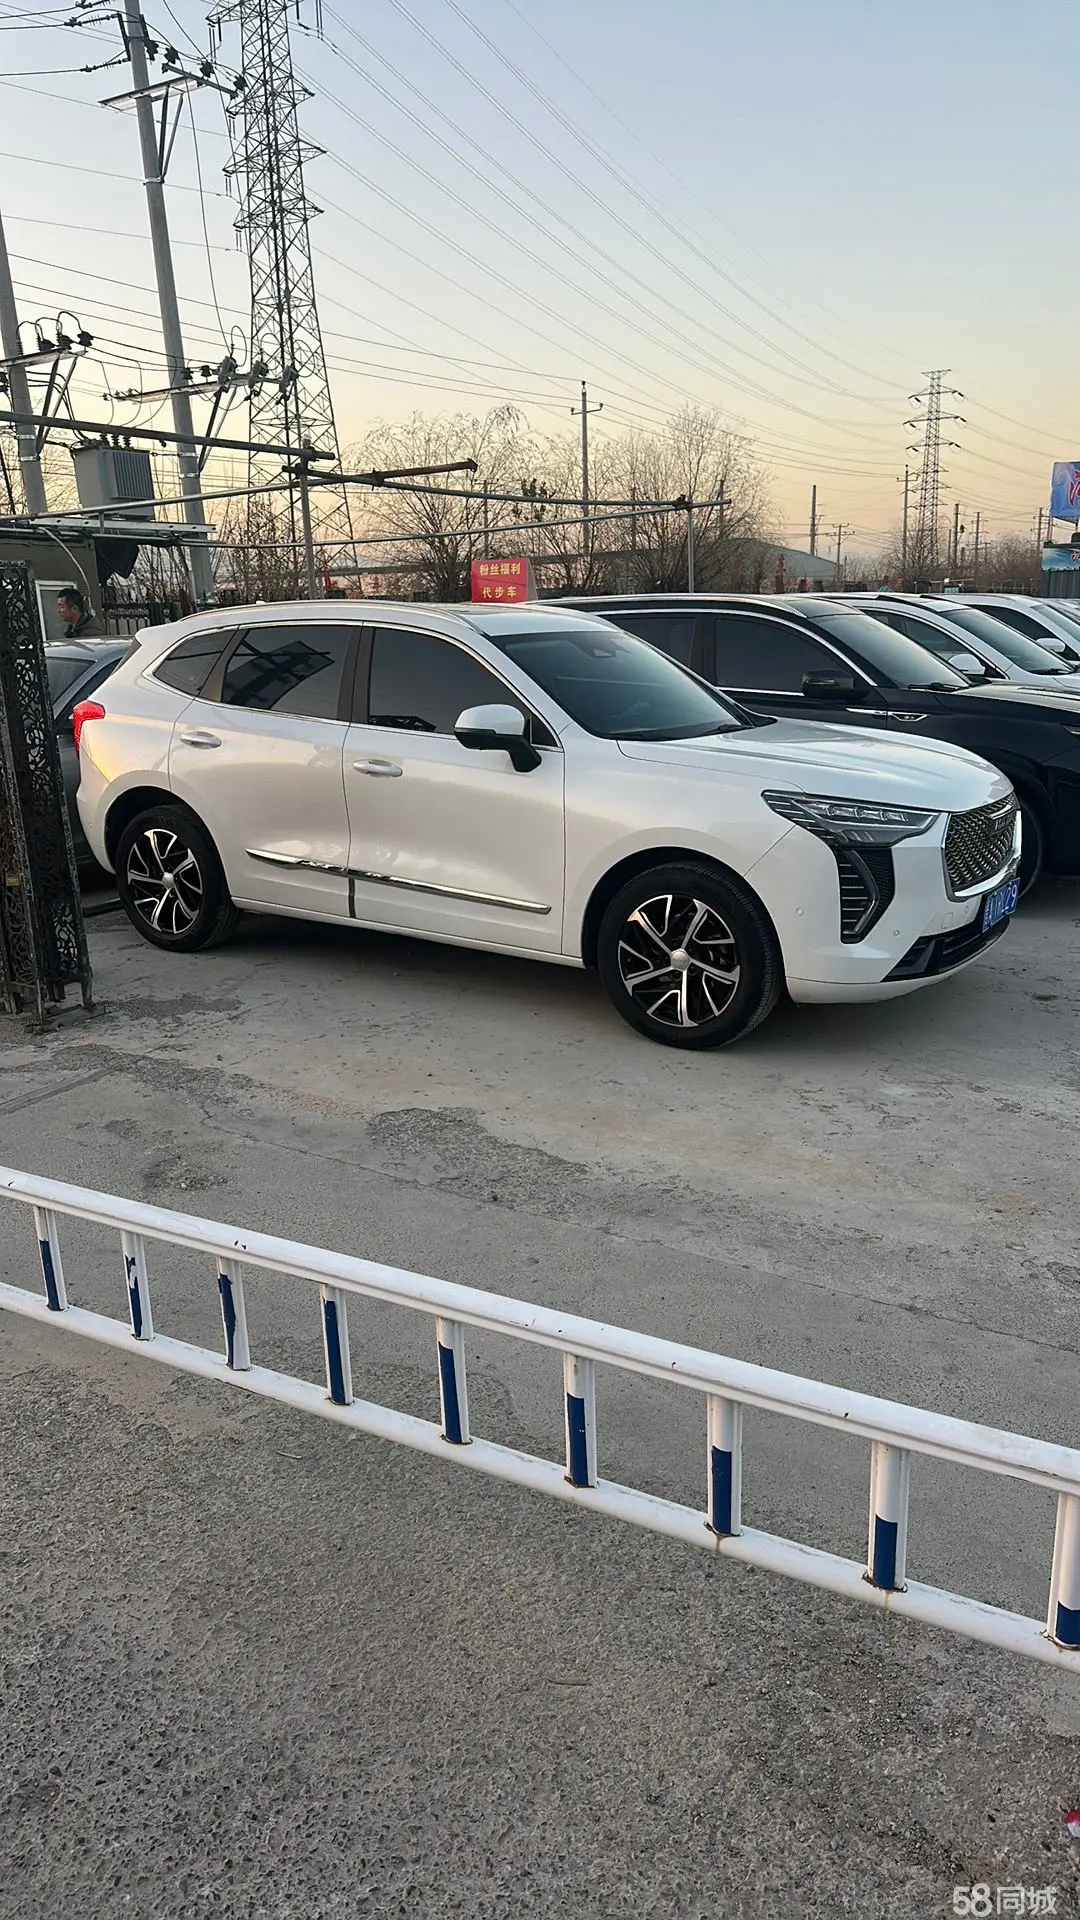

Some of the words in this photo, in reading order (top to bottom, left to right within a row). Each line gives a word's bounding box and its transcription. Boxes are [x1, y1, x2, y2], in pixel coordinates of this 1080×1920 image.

[479, 562, 521, 576] 粉丝福利
[482, 585, 517, 599] 代步车
